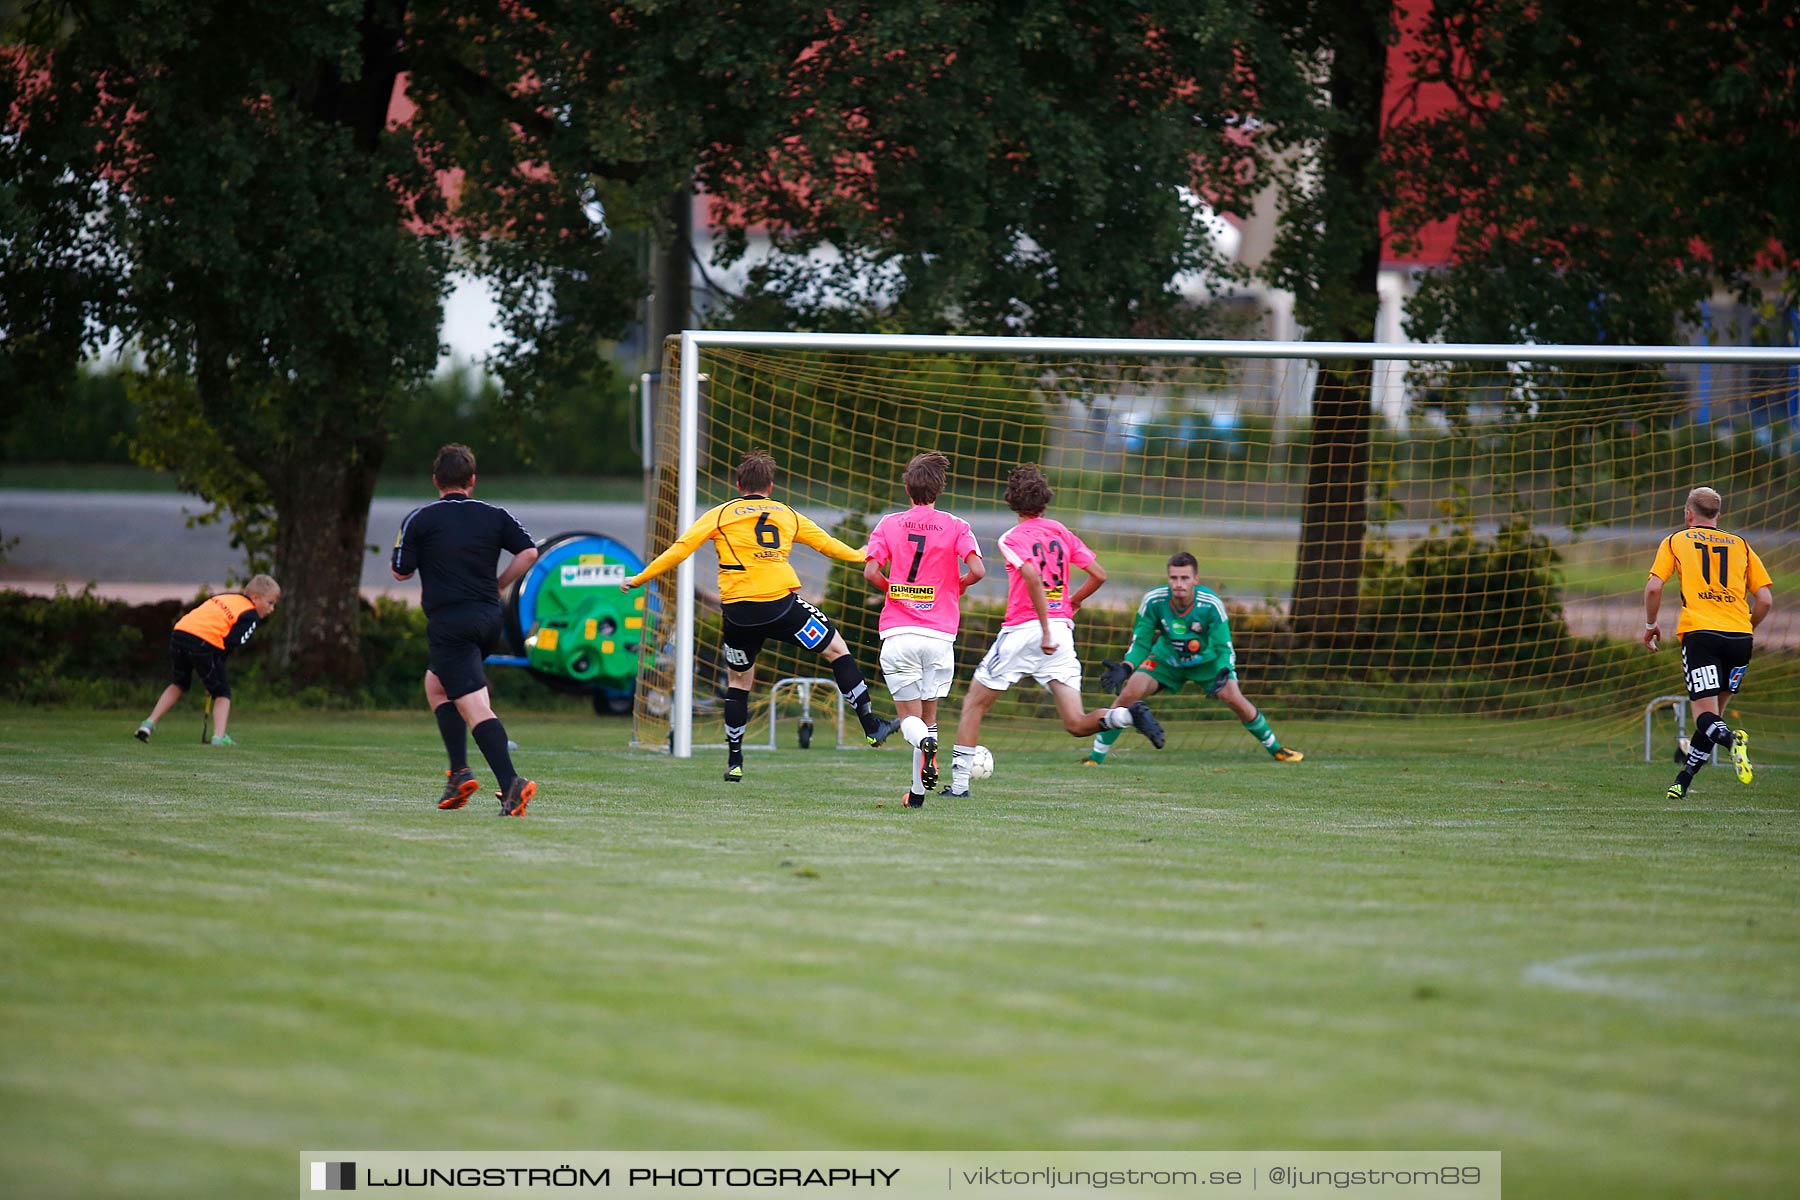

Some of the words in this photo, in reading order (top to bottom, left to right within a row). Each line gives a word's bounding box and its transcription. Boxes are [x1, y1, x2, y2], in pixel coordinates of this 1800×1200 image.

[754, 512, 780, 549] 6
[906, 533, 927, 583] 7
[1694, 542, 1729, 588] 11
[1691, 664, 1720, 693] SLA
